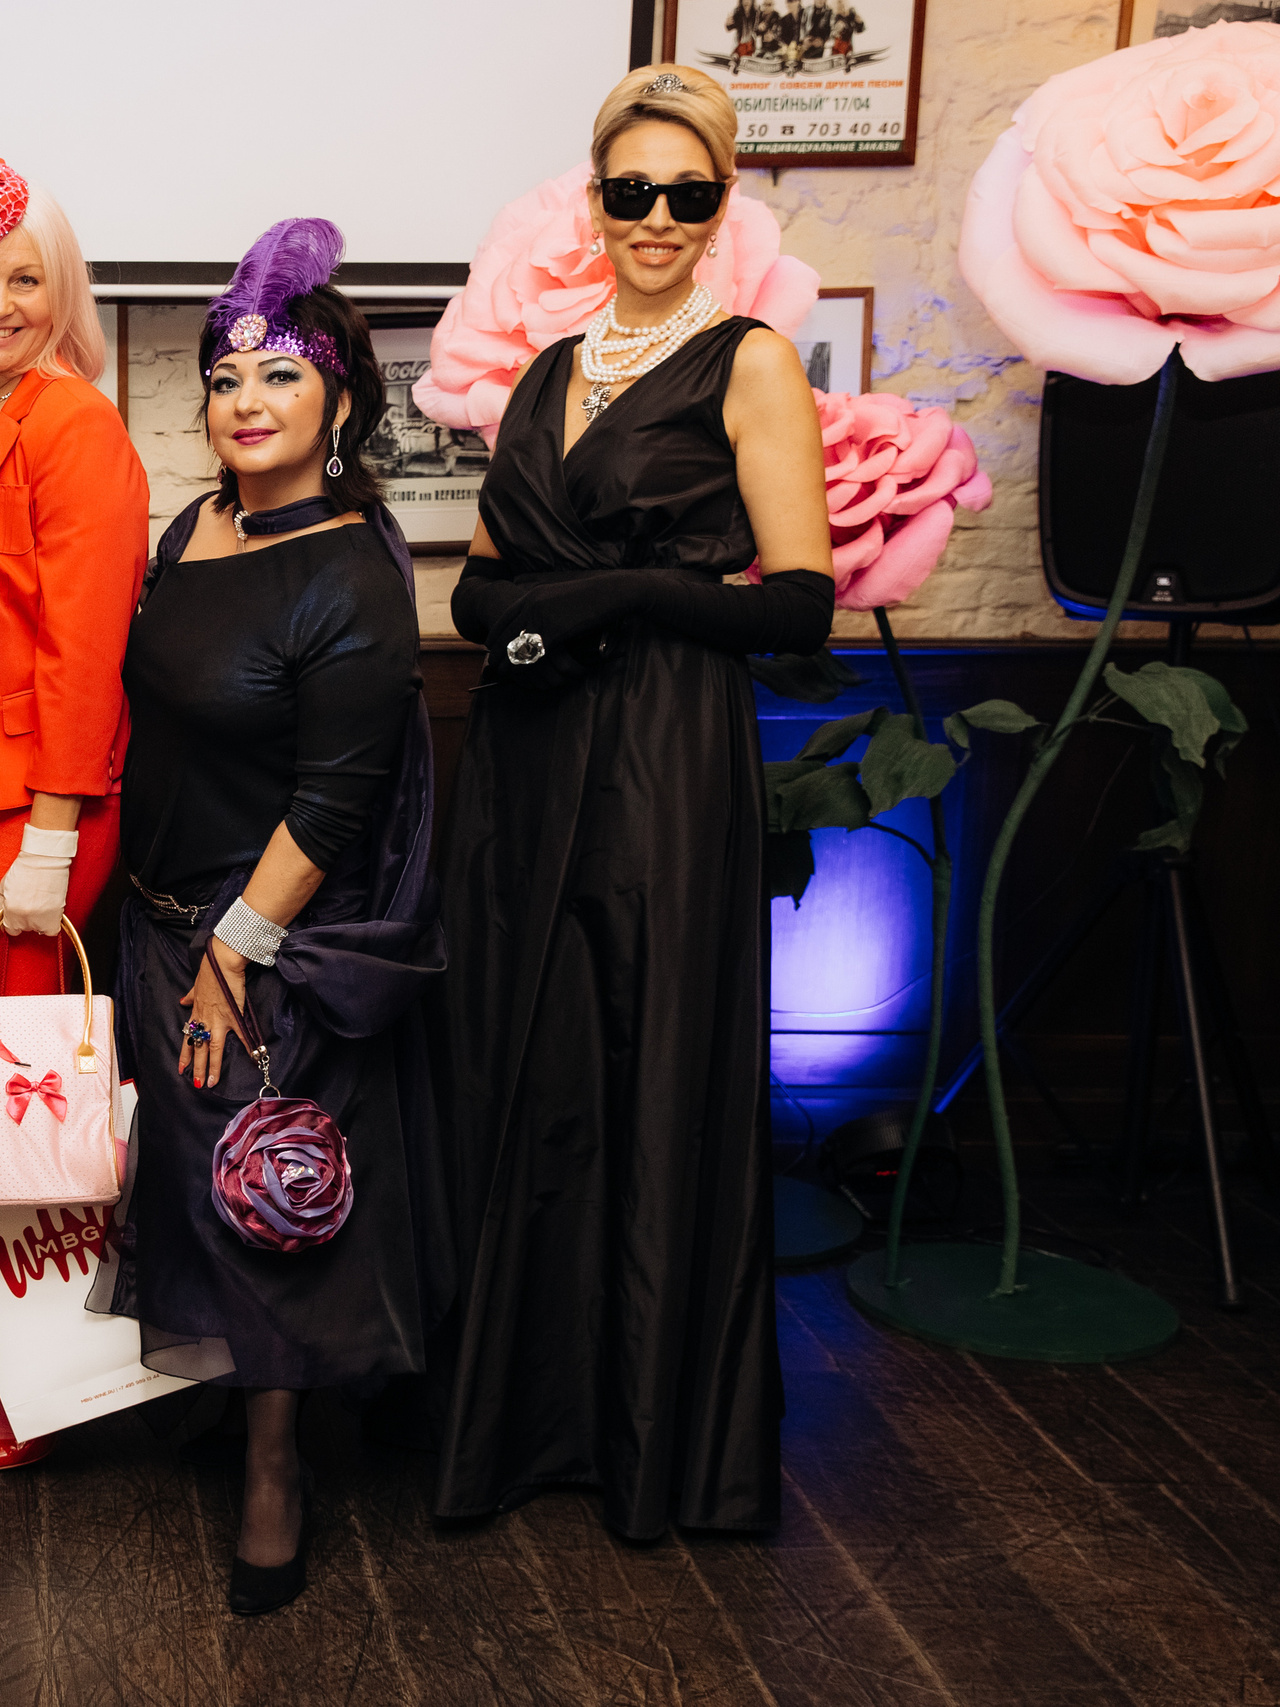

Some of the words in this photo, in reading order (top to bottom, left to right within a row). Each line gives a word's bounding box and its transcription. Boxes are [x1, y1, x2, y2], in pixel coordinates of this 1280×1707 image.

[729, 82, 770, 90] ЭПИЛОГ
[780, 81, 823, 90] СОВСЕМ
[825, 80, 864, 90] ДРУГИЕ
[868, 80, 904, 89] ПЕСНИ
[834, 97, 871, 112] 17/04
[746, 124, 768, 137] 50
[807, 123, 841, 137] 703
[849, 122, 871, 136] 40
[878, 122, 901, 136] 40
[756, 141, 855, 154] ИНДИВИДУАЛЬНЫЕ
[857, 141, 900, 152] ЗАКАЗЫ
[384, 361, 431, 380] Cola
[434, 489, 480, 501] REFRESHIN
[34, 1225, 100, 1259] MBG
